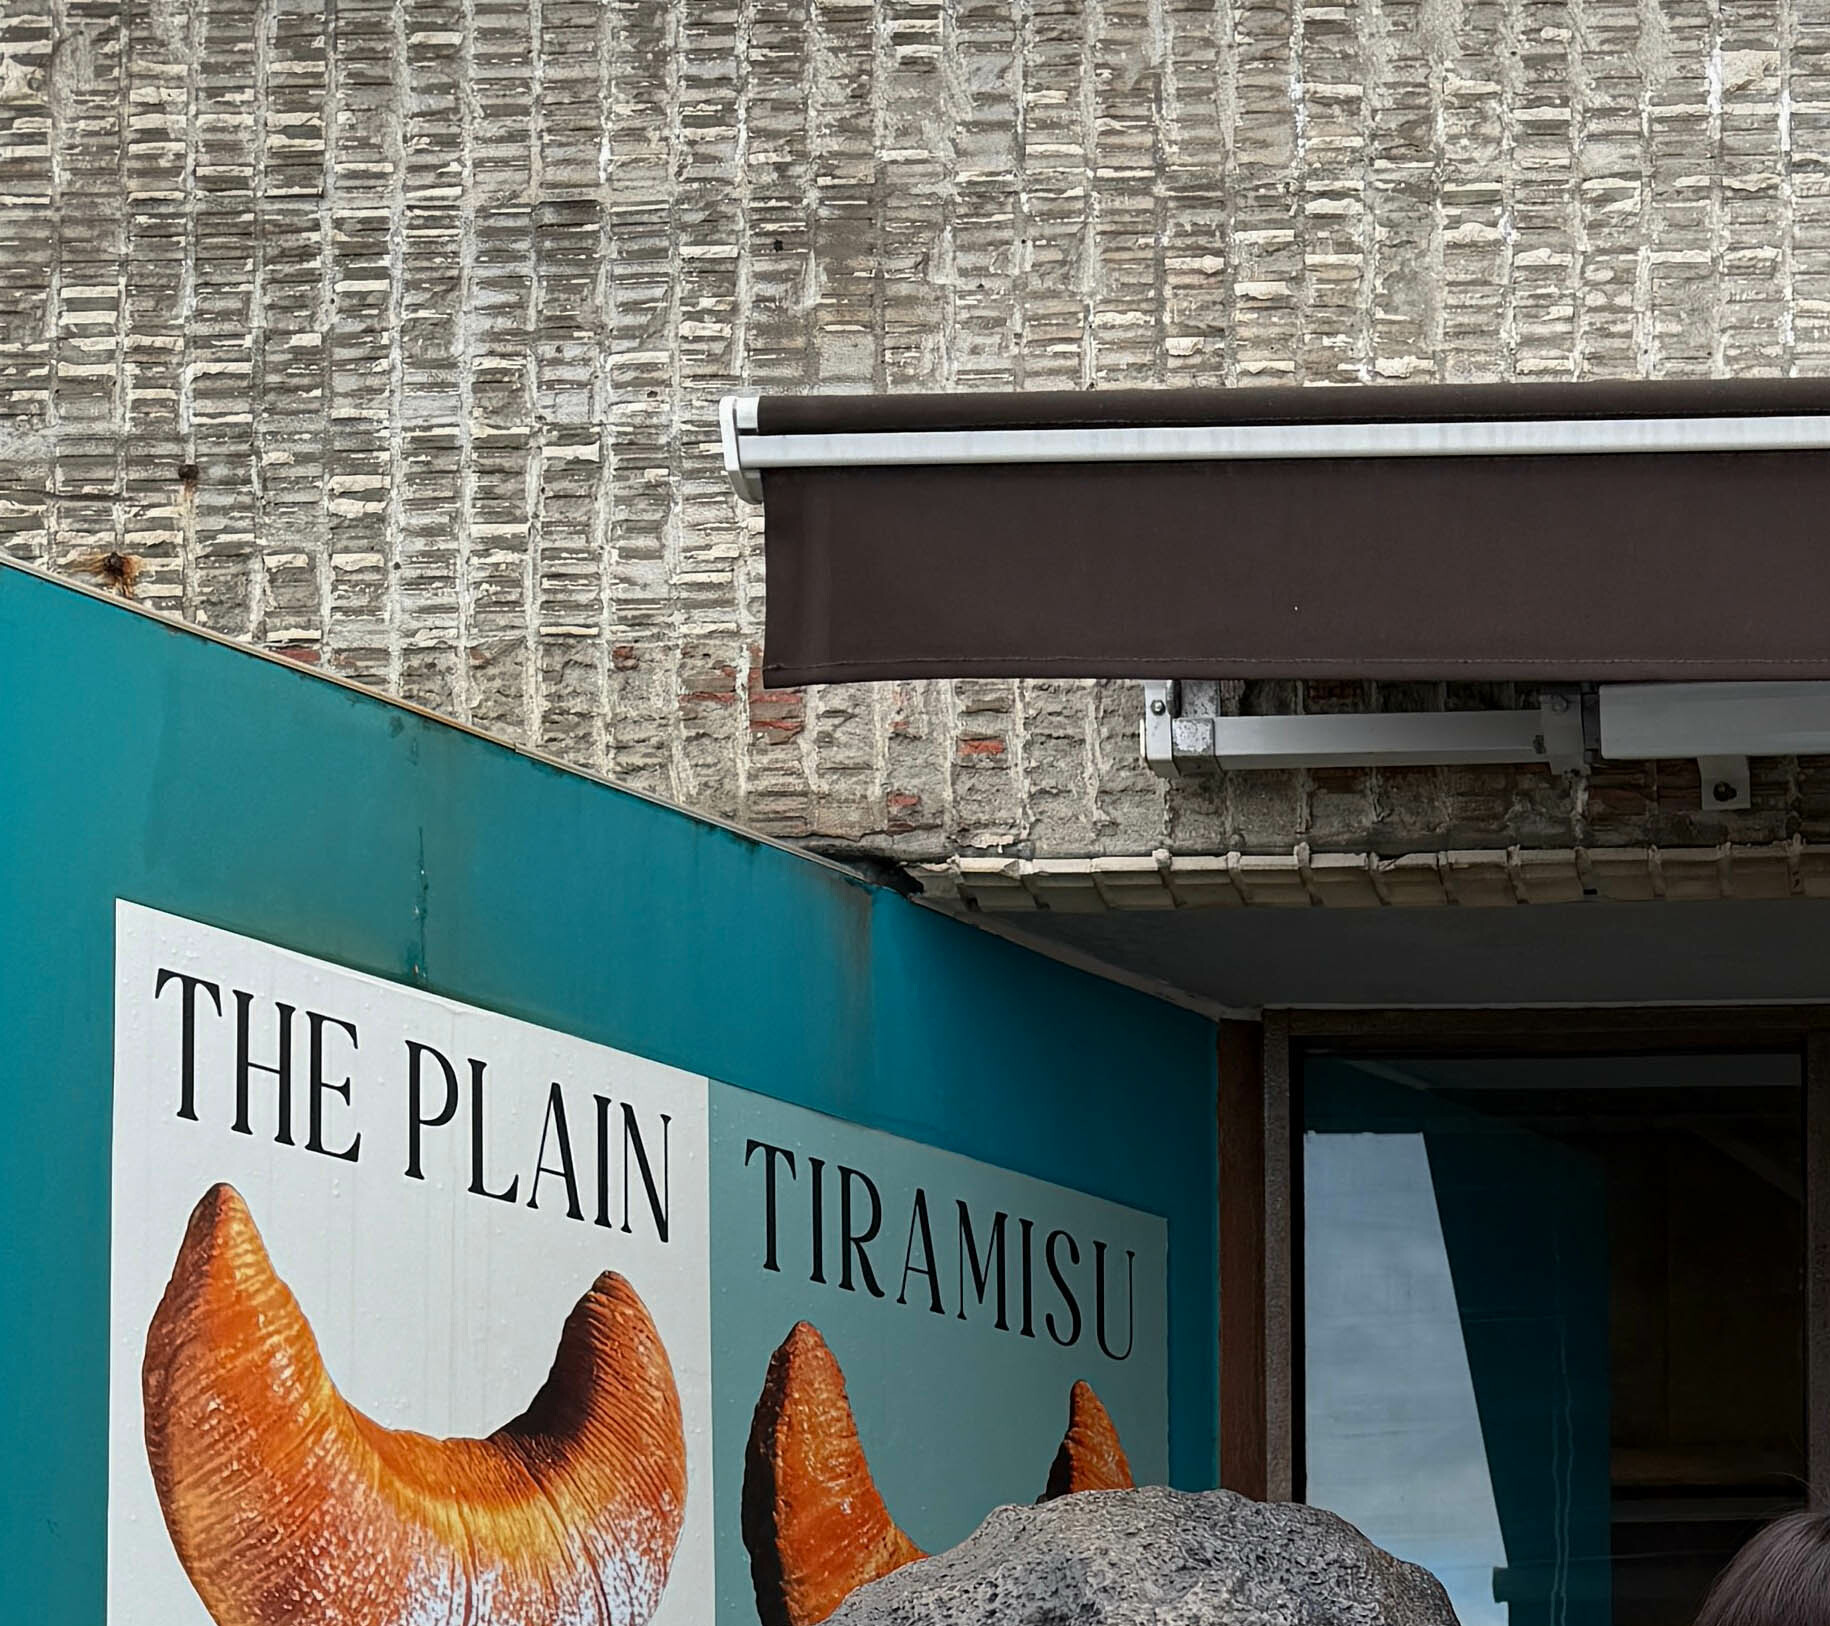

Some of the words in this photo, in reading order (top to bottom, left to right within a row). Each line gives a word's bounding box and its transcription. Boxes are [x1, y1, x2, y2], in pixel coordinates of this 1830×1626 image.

[154, 967, 362, 1163] THE
[404, 1040, 672, 1244] PLAIN
[745, 1138, 1136, 1361] TIRAMISU
